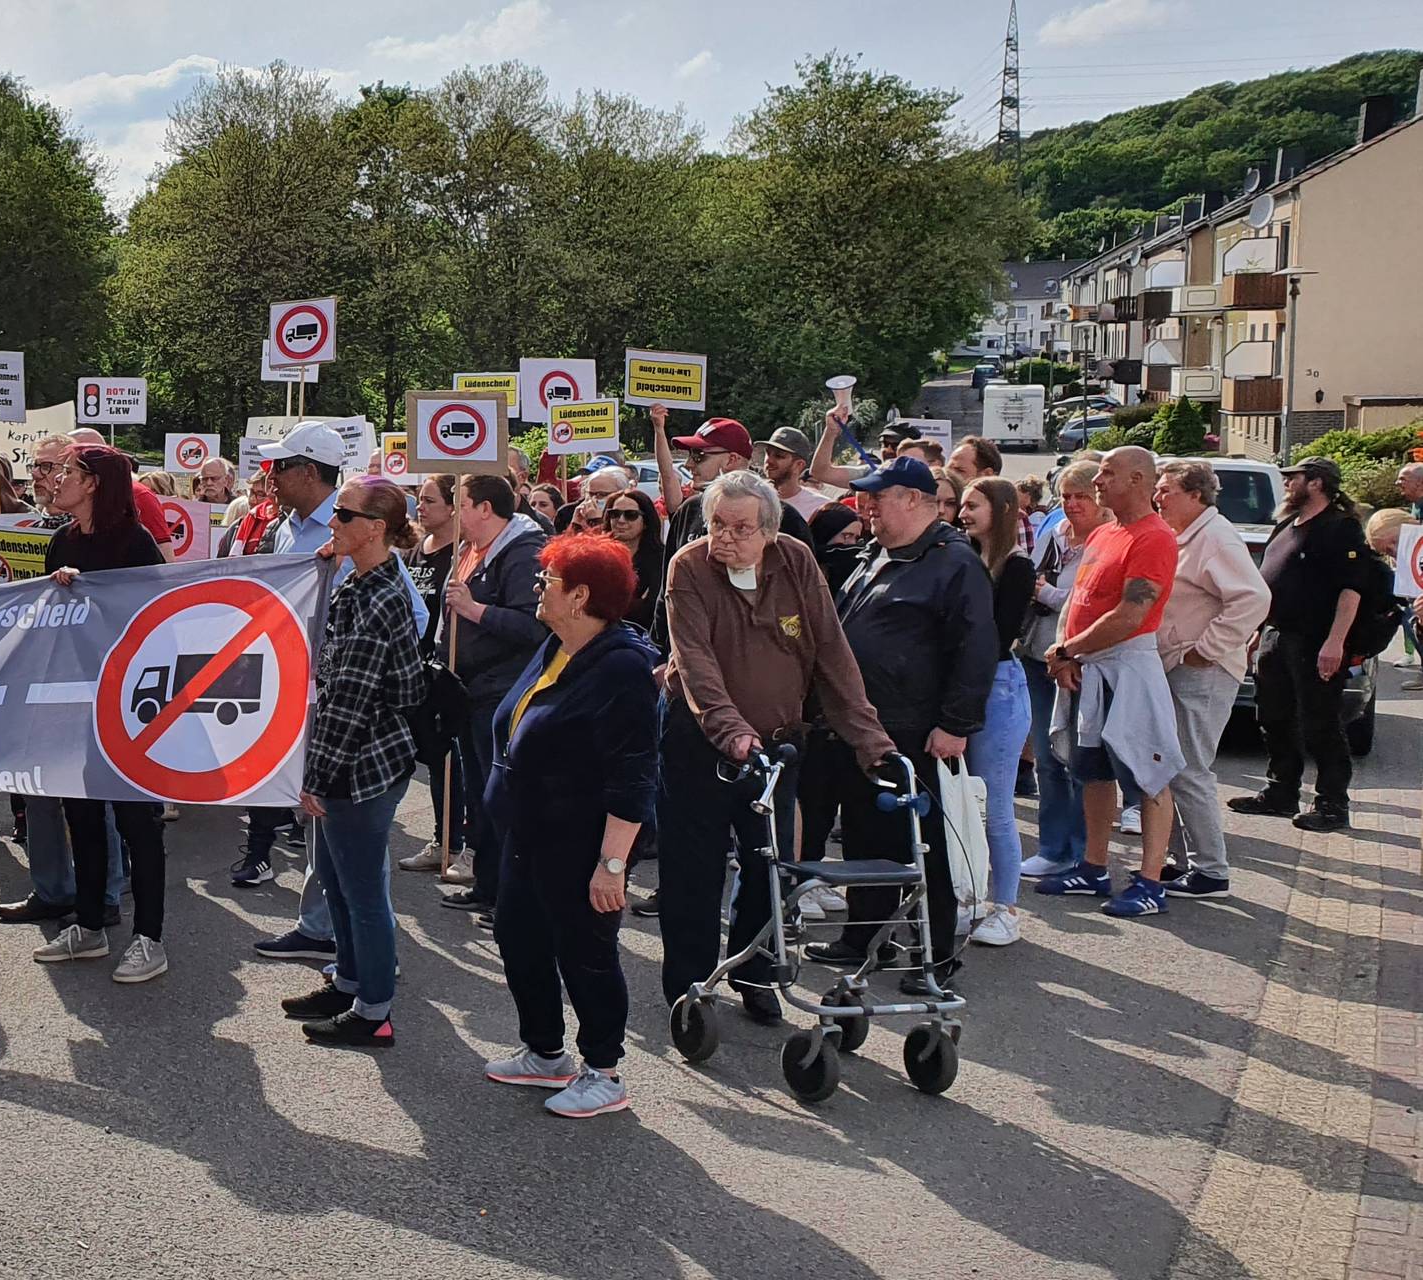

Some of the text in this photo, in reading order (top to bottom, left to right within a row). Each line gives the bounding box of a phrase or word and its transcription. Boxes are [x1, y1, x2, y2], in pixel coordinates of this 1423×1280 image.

[638, 365, 691, 377] Lkw-freie Zone
[464, 379, 511, 388] Lüdenscheid
[0, 387, 10, 396] der
[106, 388, 141, 396] ROT für
[636, 382, 692, 396] Lüdenscheid
[105, 397, 139, 405] Transit
[105, 407, 130, 415] -LKW
[559, 407, 608, 419] Lüdenscheid
[574, 426, 607, 435] freie Zone
